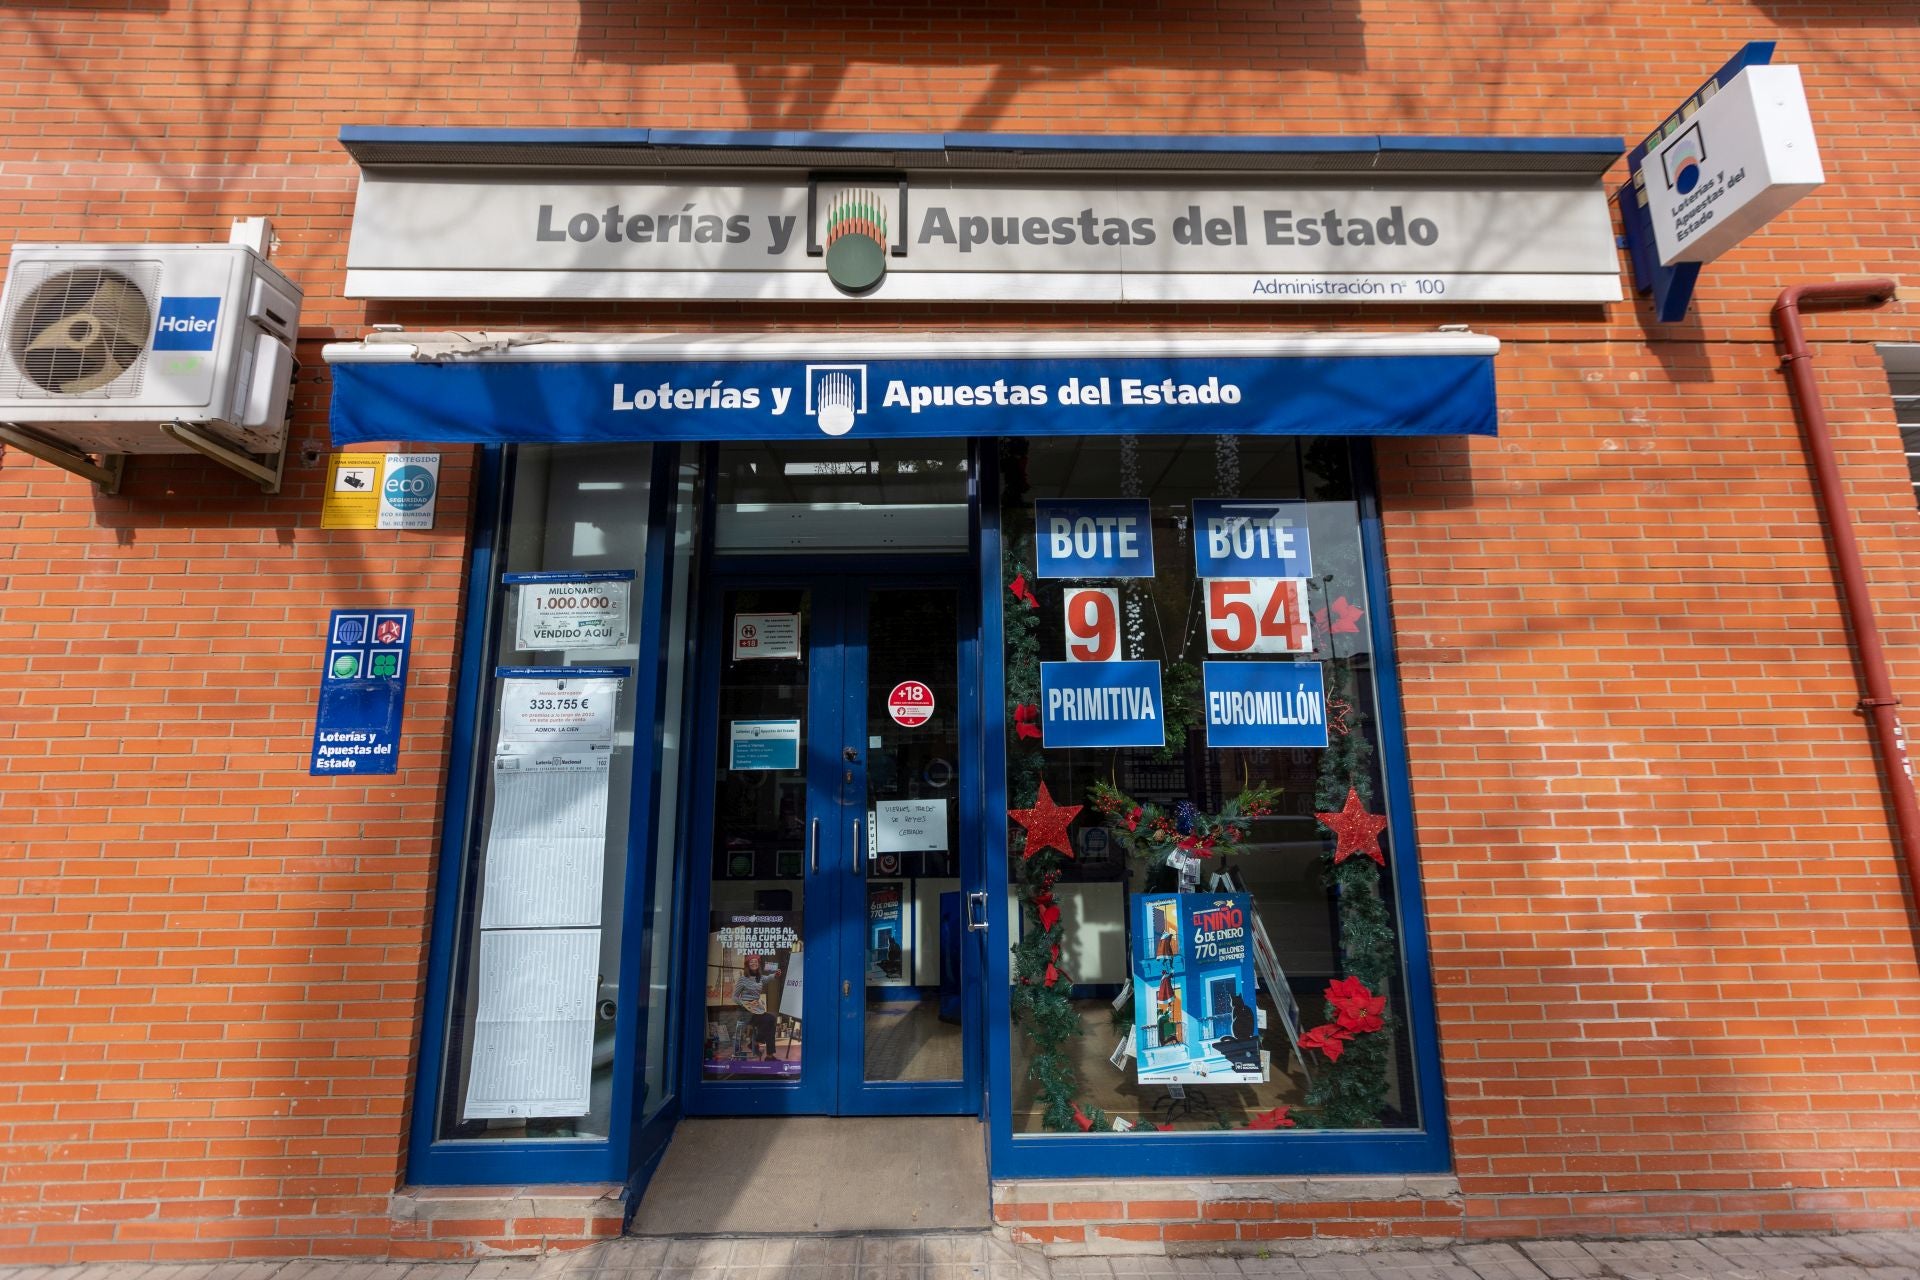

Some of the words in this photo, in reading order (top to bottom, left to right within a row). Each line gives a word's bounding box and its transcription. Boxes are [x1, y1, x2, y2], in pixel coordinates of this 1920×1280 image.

[1671, 178, 1715, 217] Loterías
[1717, 170, 1724, 184] y
[1675, 186, 1725, 230] Apuestas
[1727, 167, 1745, 189] del
[536, 202, 750, 244] Loterías
[767, 215, 797, 255] y
[917, 206, 1156, 253] Apuestas
[1172, 205, 1248, 246] del
[1263, 205, 1440, 247] Estado
[1677, 210, 1714, 242] Estado
[1252, 277, 1385, 295] Administración
[1415, 278, 1445, 295] 100
[158, 315, 216, 332] Haier
[612, 379, 760, 411] Loterías
[771, 386, 792, 415] y
[882, 378, 1048, 414] Apuestas
[1057, 377, 1111, 406] del
[1120, 376, 1242, 406] Estado
[386, 478, 425, 493] eco
[1050, 516, 1140, 560] BOTE
[1207, 516, 1297, 560] BOTE
[548, 587, 604, 595] MILLONARIO
[535, 596, 610, 610] 1.000.000
[1209, 580, 1308, 652] 54
[533, 628, 581, 639] VENDIDO
[584, 626, 614, 638] AQUÍ
[1067, 590, 1117, 662] 9
[898, 686, 924, 701] +18
[529, 698, 578, 710] 333.755
[580, 698, 589, 710] €
[1048, 686, 1156, 722] PRIMITIVA
[1209, 683, 1322, 726] EUROMILLÓN
[319, 731, 367, 742] Loterías
[369, 733, 376, 744] y
[318, 744, 372, 757] Apuestas
[373, 743, 391, 755] del
[316, 758, 357, 769] Estado
[1203, 908, 1243, 932] NIÑO
[716, 934, 734, 942] MES
[734, 934, 758, 942] PARA
[758, 934, 799, 942] CUMPLIR
[720, 927, 752, 935] 20.000
[1194, 928, 1204, 944] 6
[1204, 931, 1216, 943] DE
[1216, 927, 1244, 941] ENERO
[721, 941, 733, 949] TU
[763, 941, 775, 949] DE
[776, 941, 793, 949] SER
[737, 948, 776, 956] PINTORA
[1195, 942, 1218, 959] 770
[1218, 944, 1245, 955] MILLONES
